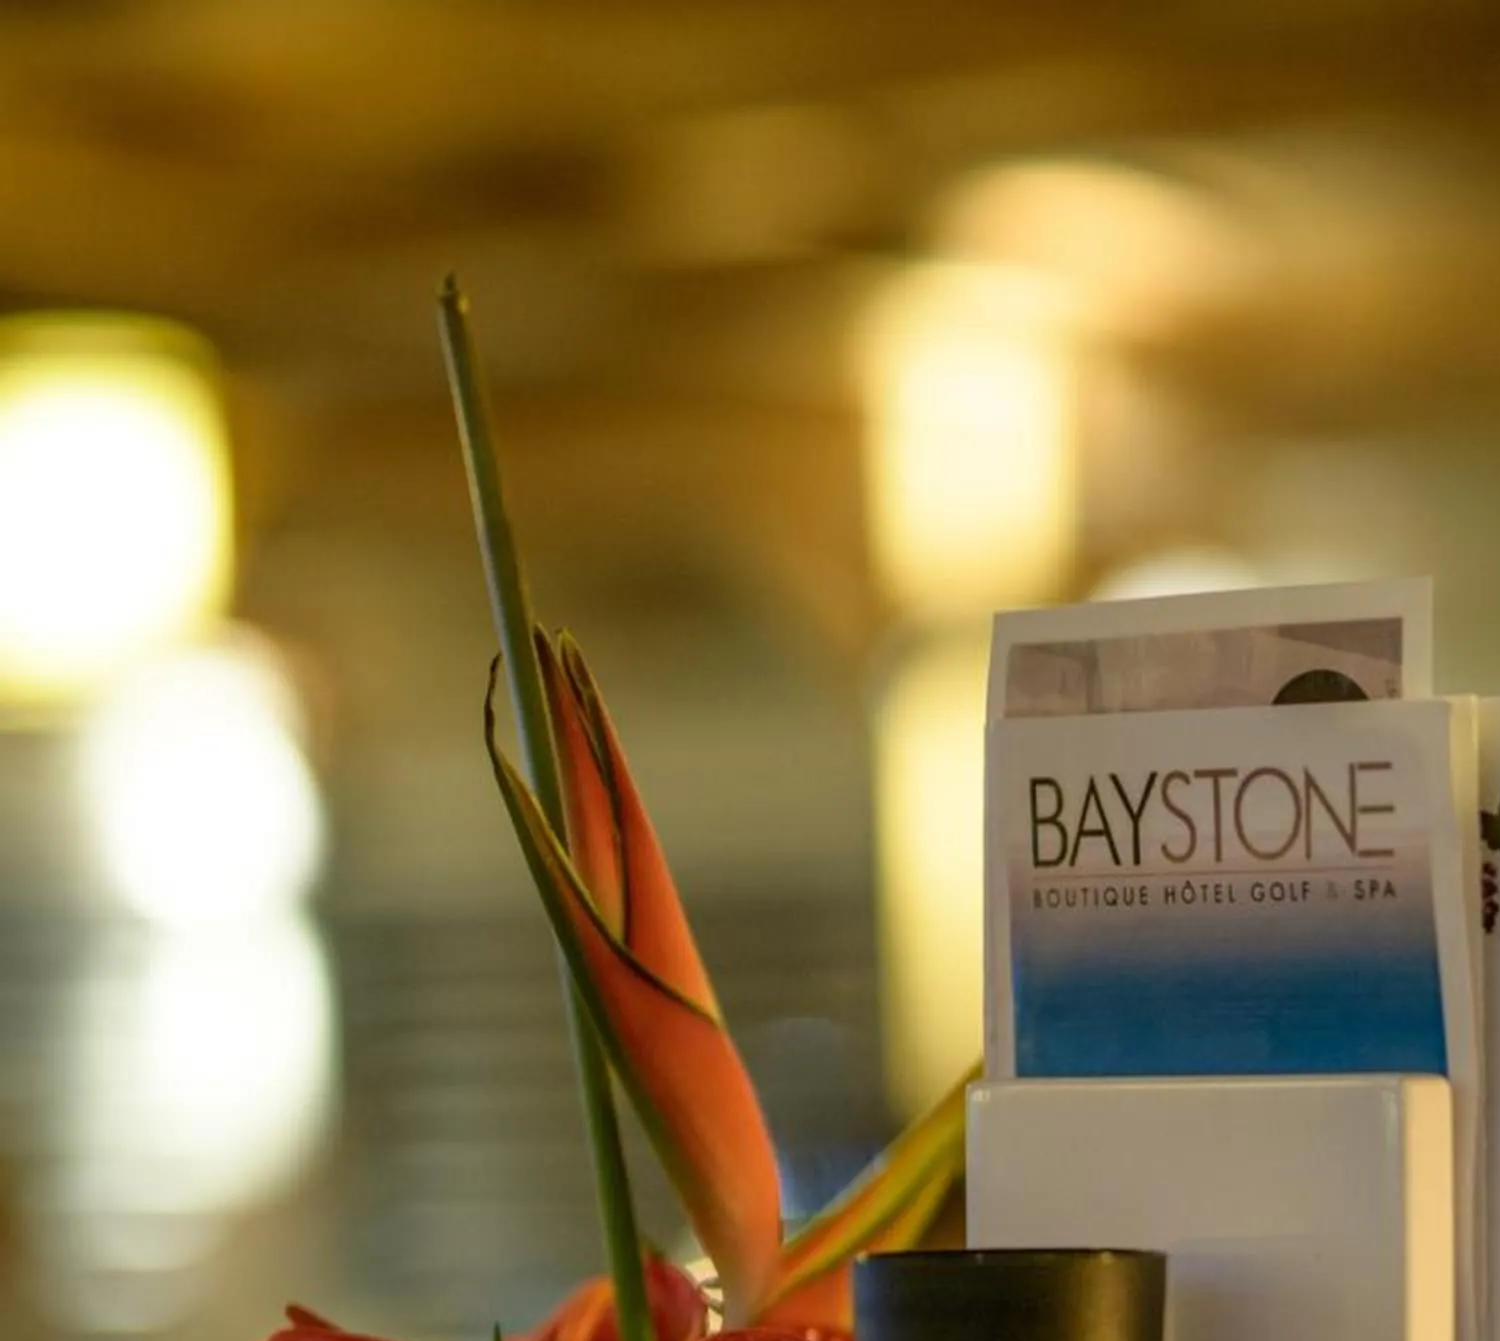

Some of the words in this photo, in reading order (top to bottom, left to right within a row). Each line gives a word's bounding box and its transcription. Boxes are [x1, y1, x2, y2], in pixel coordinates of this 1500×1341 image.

[1030, 761, 1395, 868] BAYSTONE
[1033, 885, 1149, 909] BOUTIQUE
[1163, 879, 1237, 904] HÔTEL
[1251, 880, 1311, 902] GOLF
[1354, 878, 1397, 900] SPA
